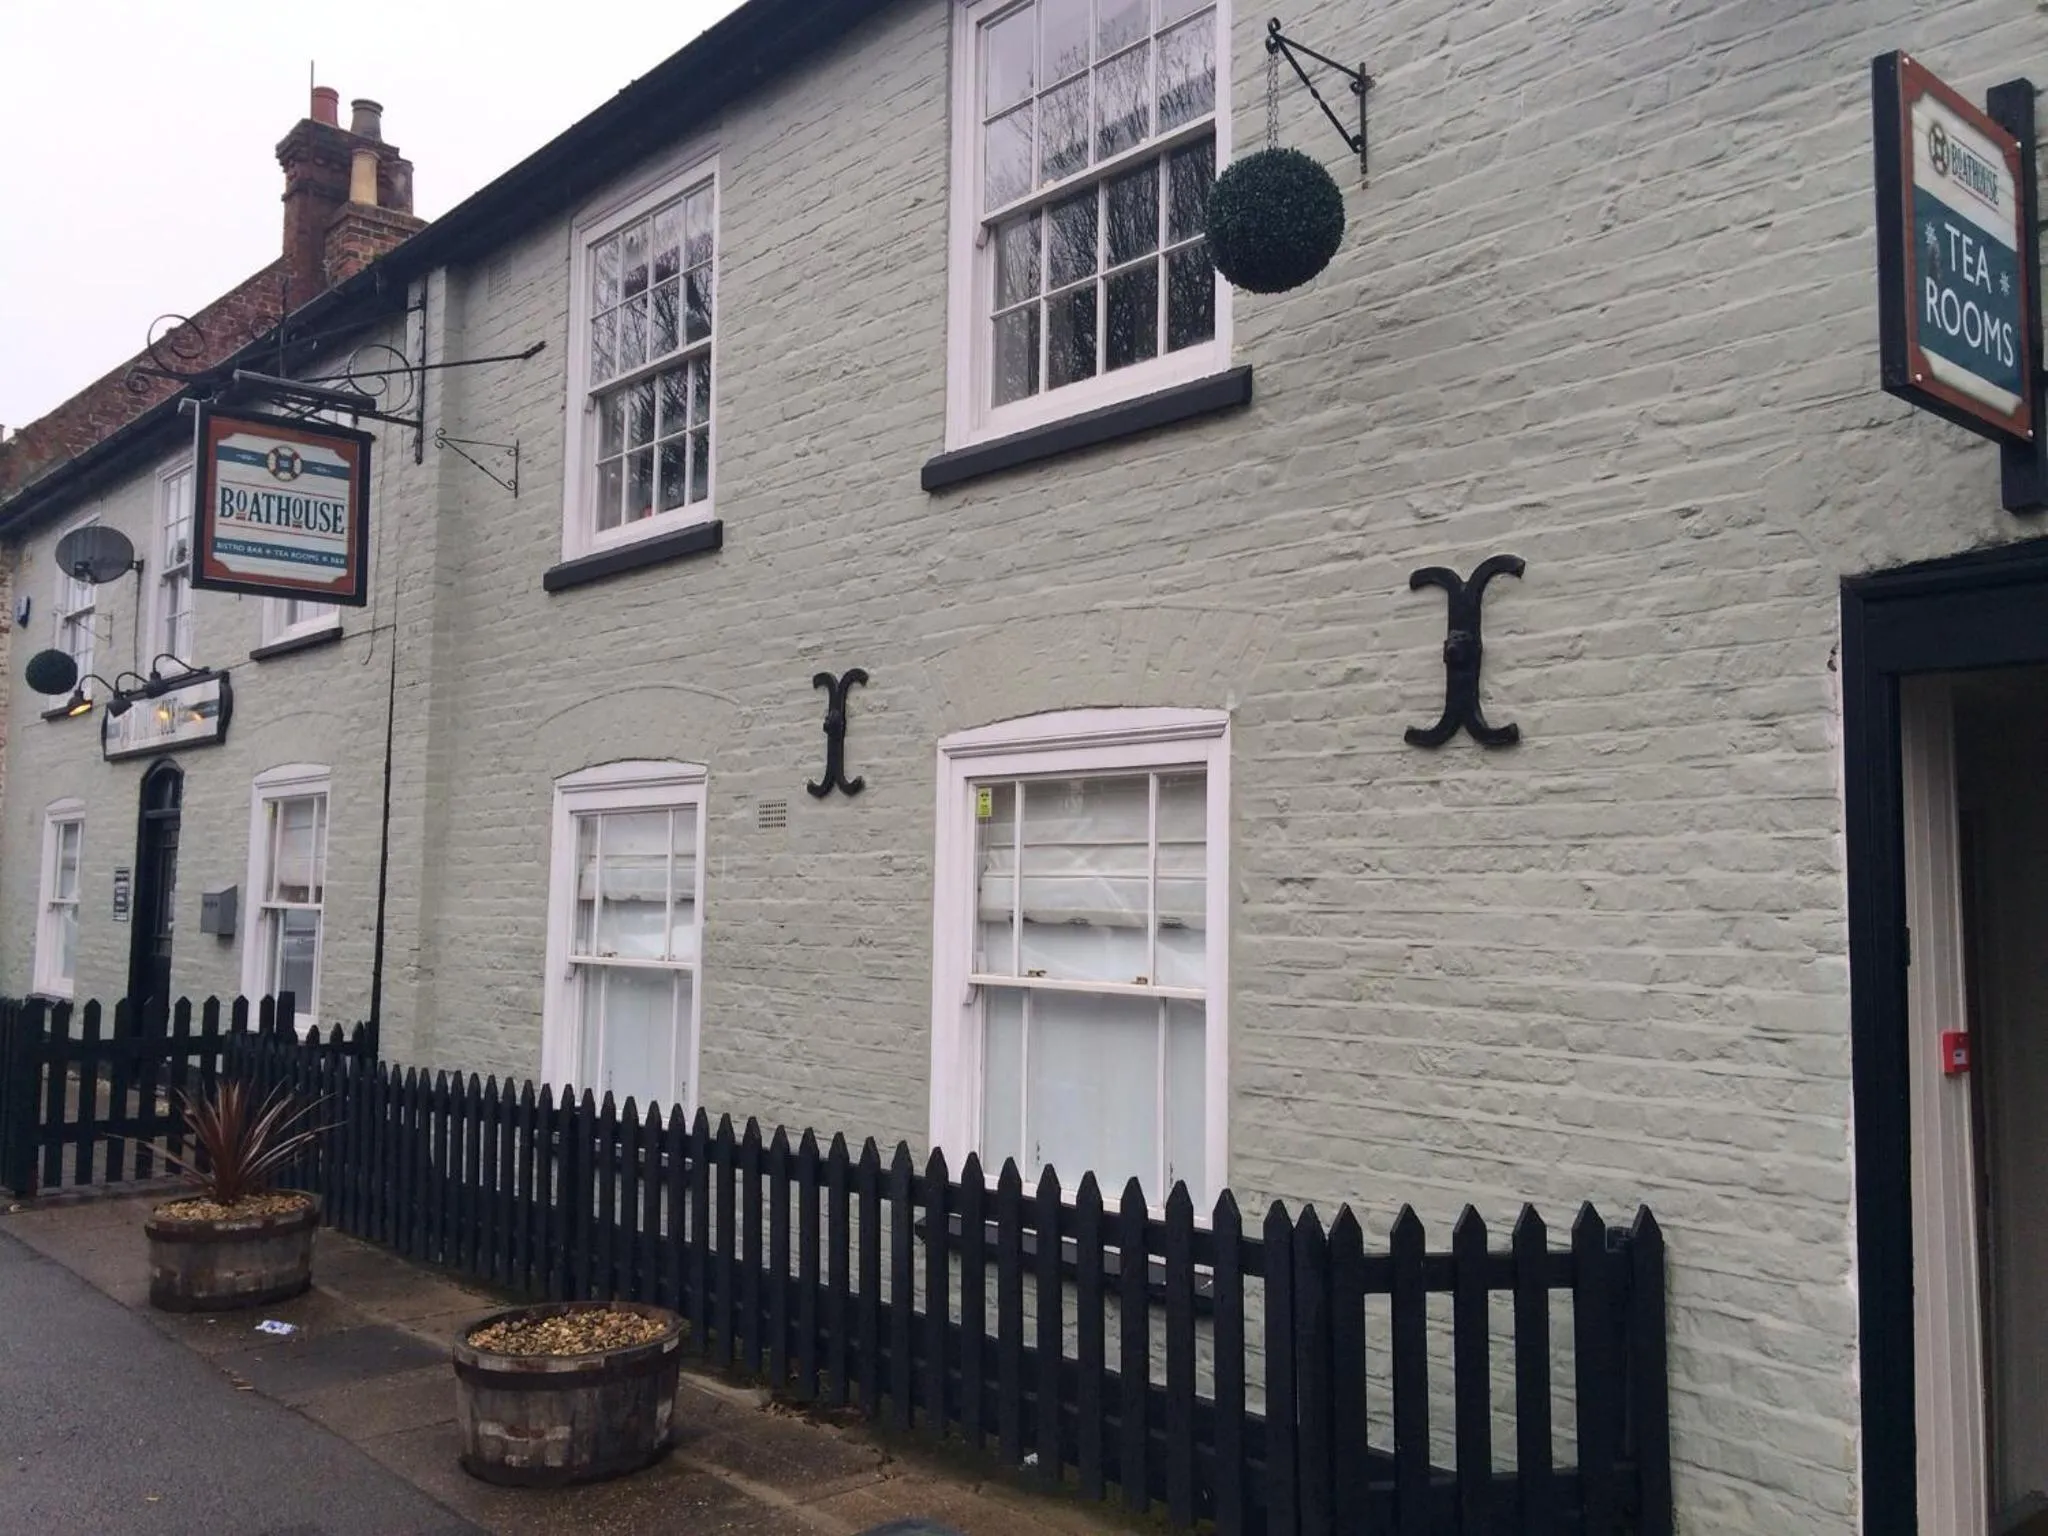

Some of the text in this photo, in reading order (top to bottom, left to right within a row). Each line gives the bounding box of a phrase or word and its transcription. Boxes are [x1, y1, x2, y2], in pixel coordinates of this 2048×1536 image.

[1951, 143, 1999, 206] BOATHOUSE
[1944, 222, 1992, 295] TEA
[1925, 276, 2014, 368] ROOMS
[220, 487, 345, 535] BOATHOUSE
[216, 541, 245, 552] BISTRO
[274, 549, 289, 558] TEA
[291, 551, 320, 562] ROOMS
